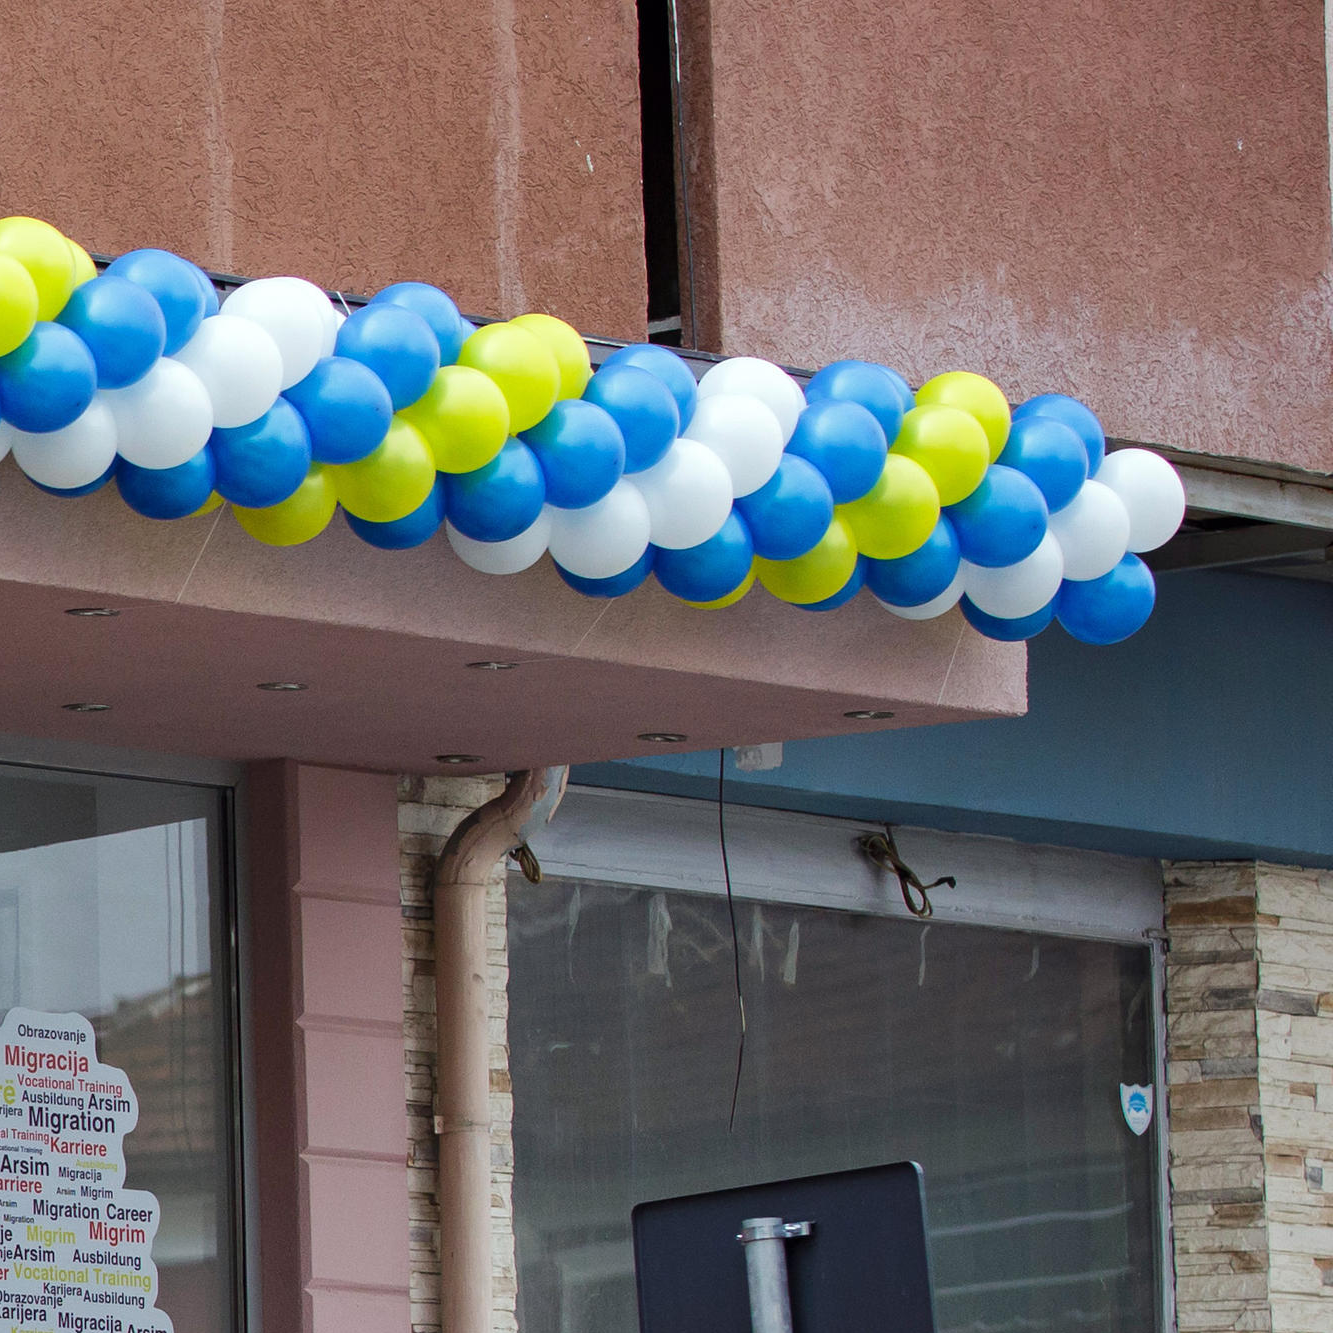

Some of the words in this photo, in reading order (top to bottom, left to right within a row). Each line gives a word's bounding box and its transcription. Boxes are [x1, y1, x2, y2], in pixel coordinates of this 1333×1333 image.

[18, 1024, 86, 1044] Obrazovanje
[5, 1045, 89, 1077] Migracija
[17, 1074, 74, 1091] Vocational
[78, 1079, 123, 1098] Training
[22, 1090, 84, 1110] Ausbildung
[88, 1094, 130, 1112] Arsim
[28, 1106, 115, 1134] Migration
[11, 1128, 49, 1144] Training
[50, 1136, 107, 1157] Karriere
[0, 1154, 49, 1176] Arsim
[58, 1167, 102, 1182] Migracija
[80, 1186, 113, 1201] Migrim
[3, 1214, 34, 1224] Migration
[33, 1199, 100, 1220] Migration
[106, 1203, 153, 1222] Career
[26, 1225, 76, 1247] Migrim
[89, 1221, 145, 1246] Migrim
[13, 1244, 55, 1262] Arsim
[72, 1249, 141, 1270] Ausbildung
[13, 1263, 88, 1283] Vocational
[93, 1268, 151, 1292] Training
[43, 1282, 82, 1298] Karijera
[83, 1290, 145, 1309] Ausbildung
[58, 1312, 122, 1333] Migracija
